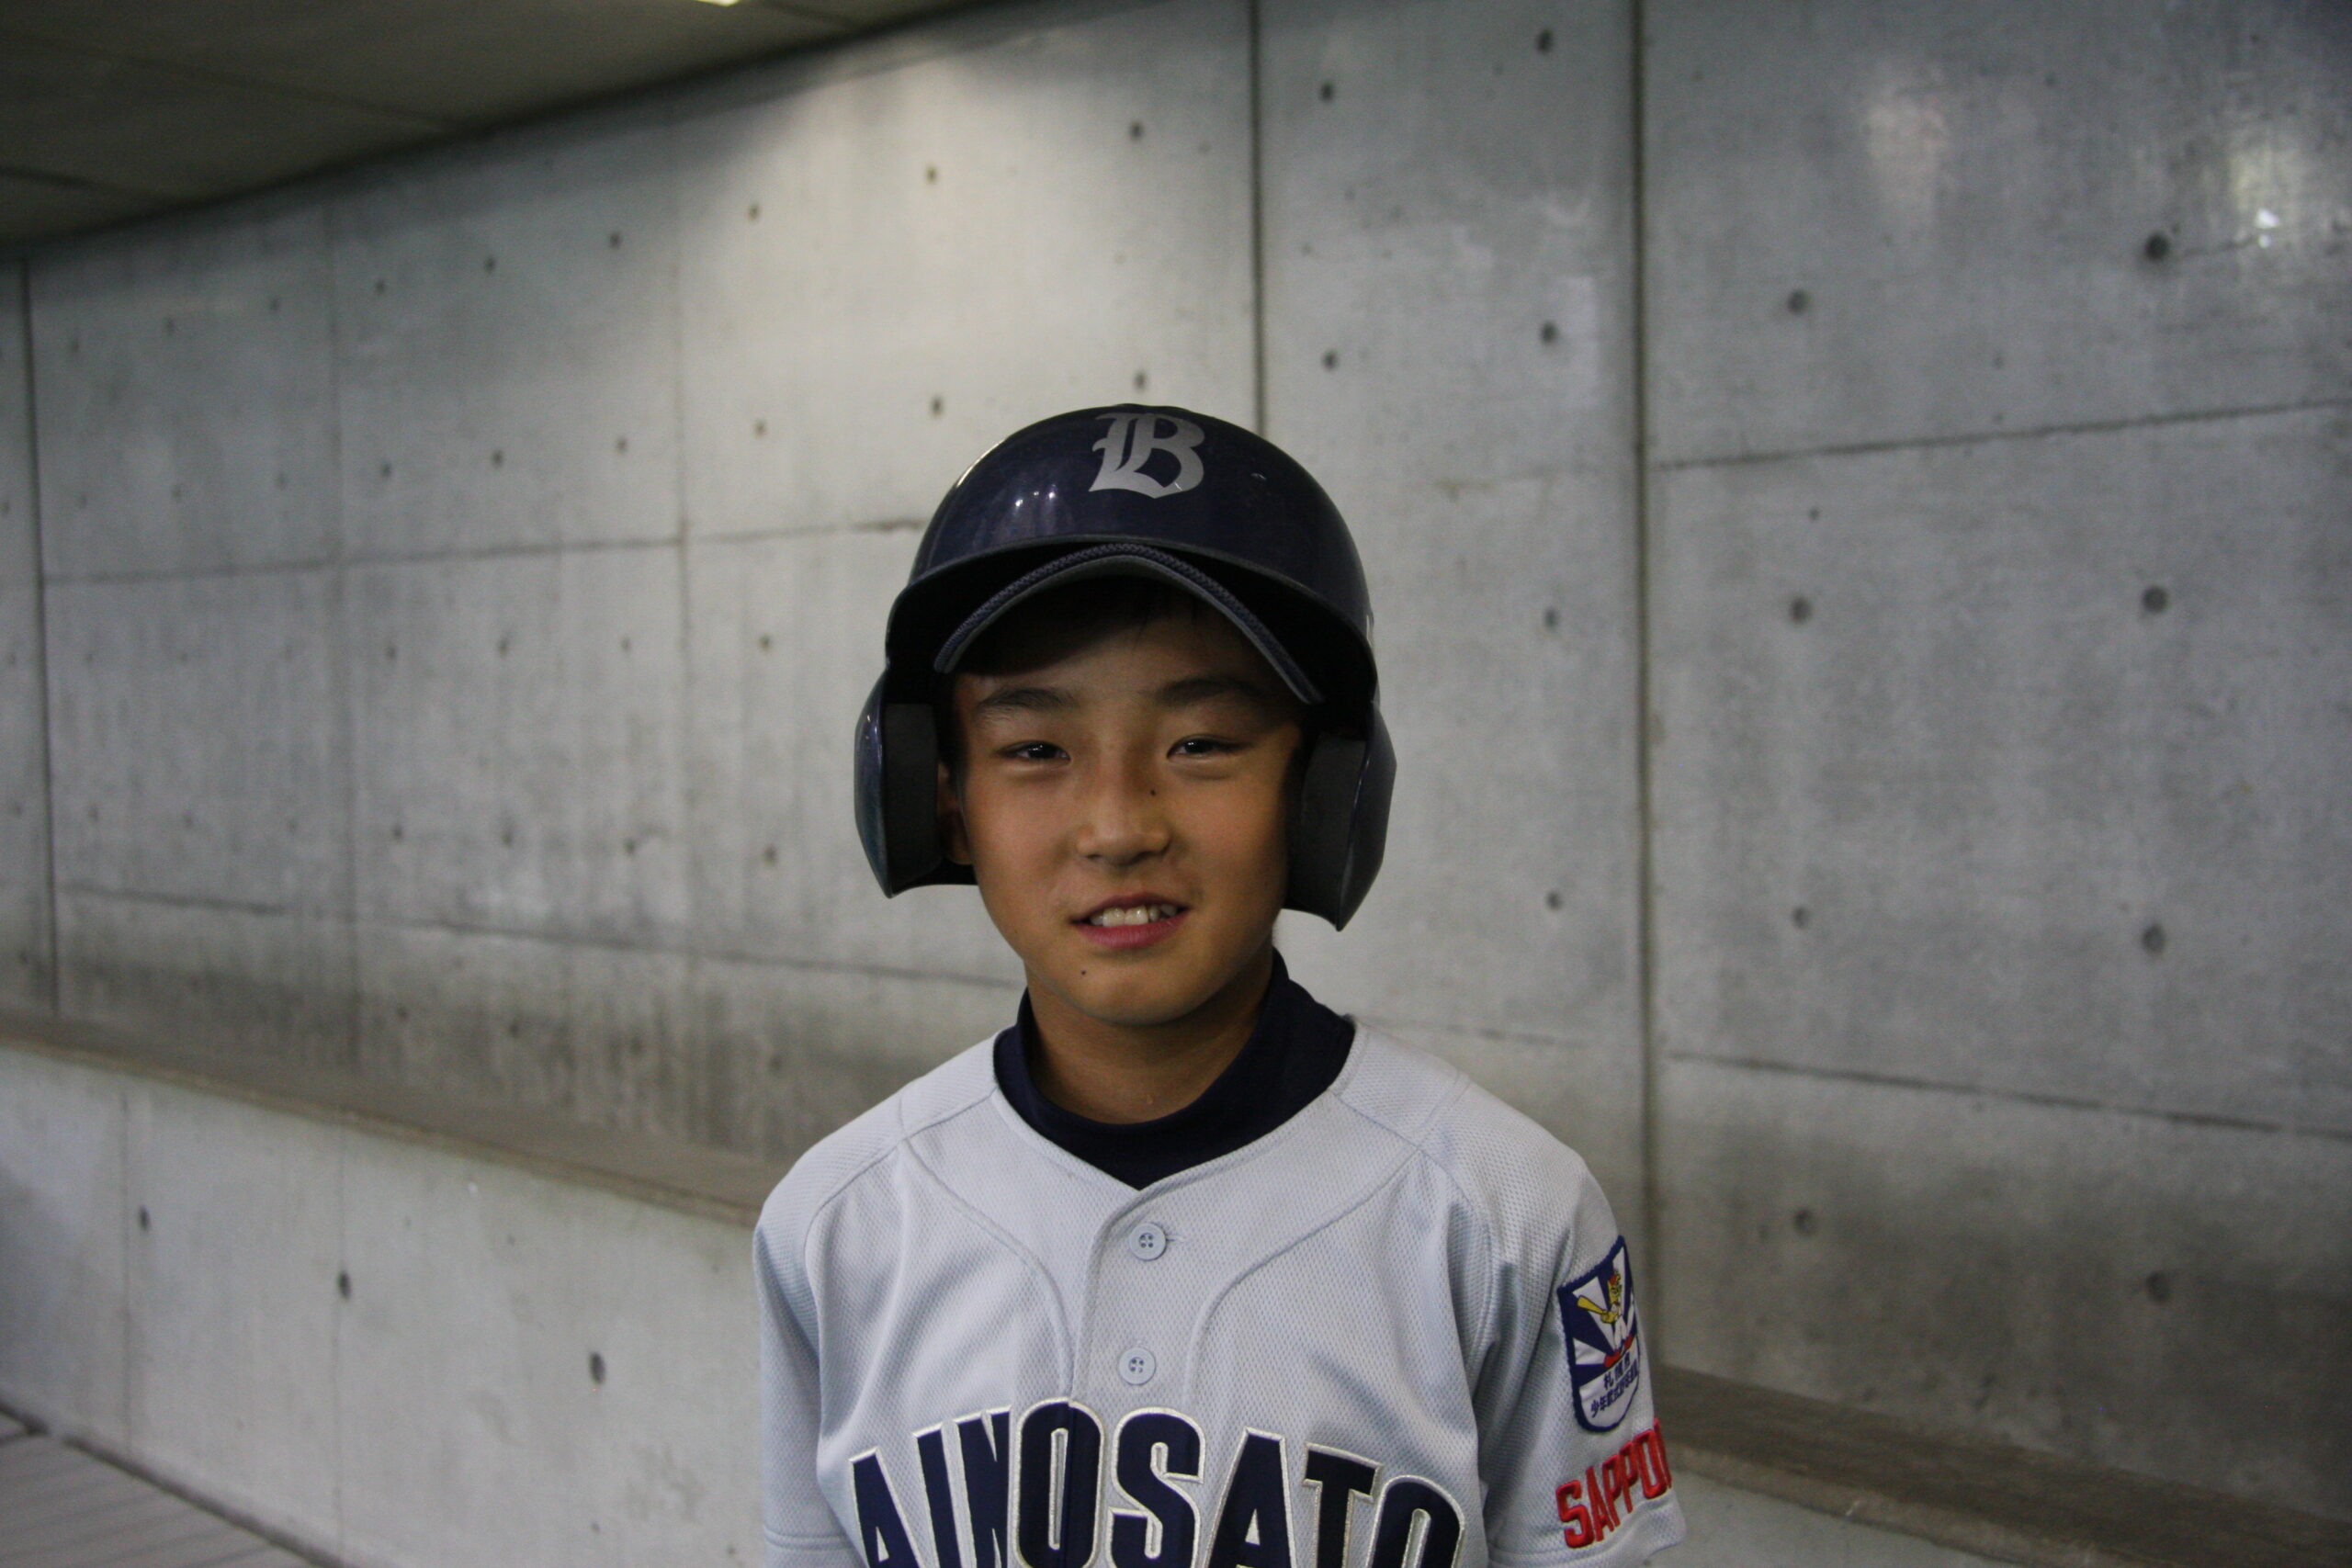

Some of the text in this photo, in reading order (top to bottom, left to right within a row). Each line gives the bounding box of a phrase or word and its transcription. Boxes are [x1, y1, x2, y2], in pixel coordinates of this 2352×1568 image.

[1088, 412, 1205, 500] B
[849, 1396, 1465, 1568] AINOSATO
[1555, 1417, 1672, 1549] SAPPO
